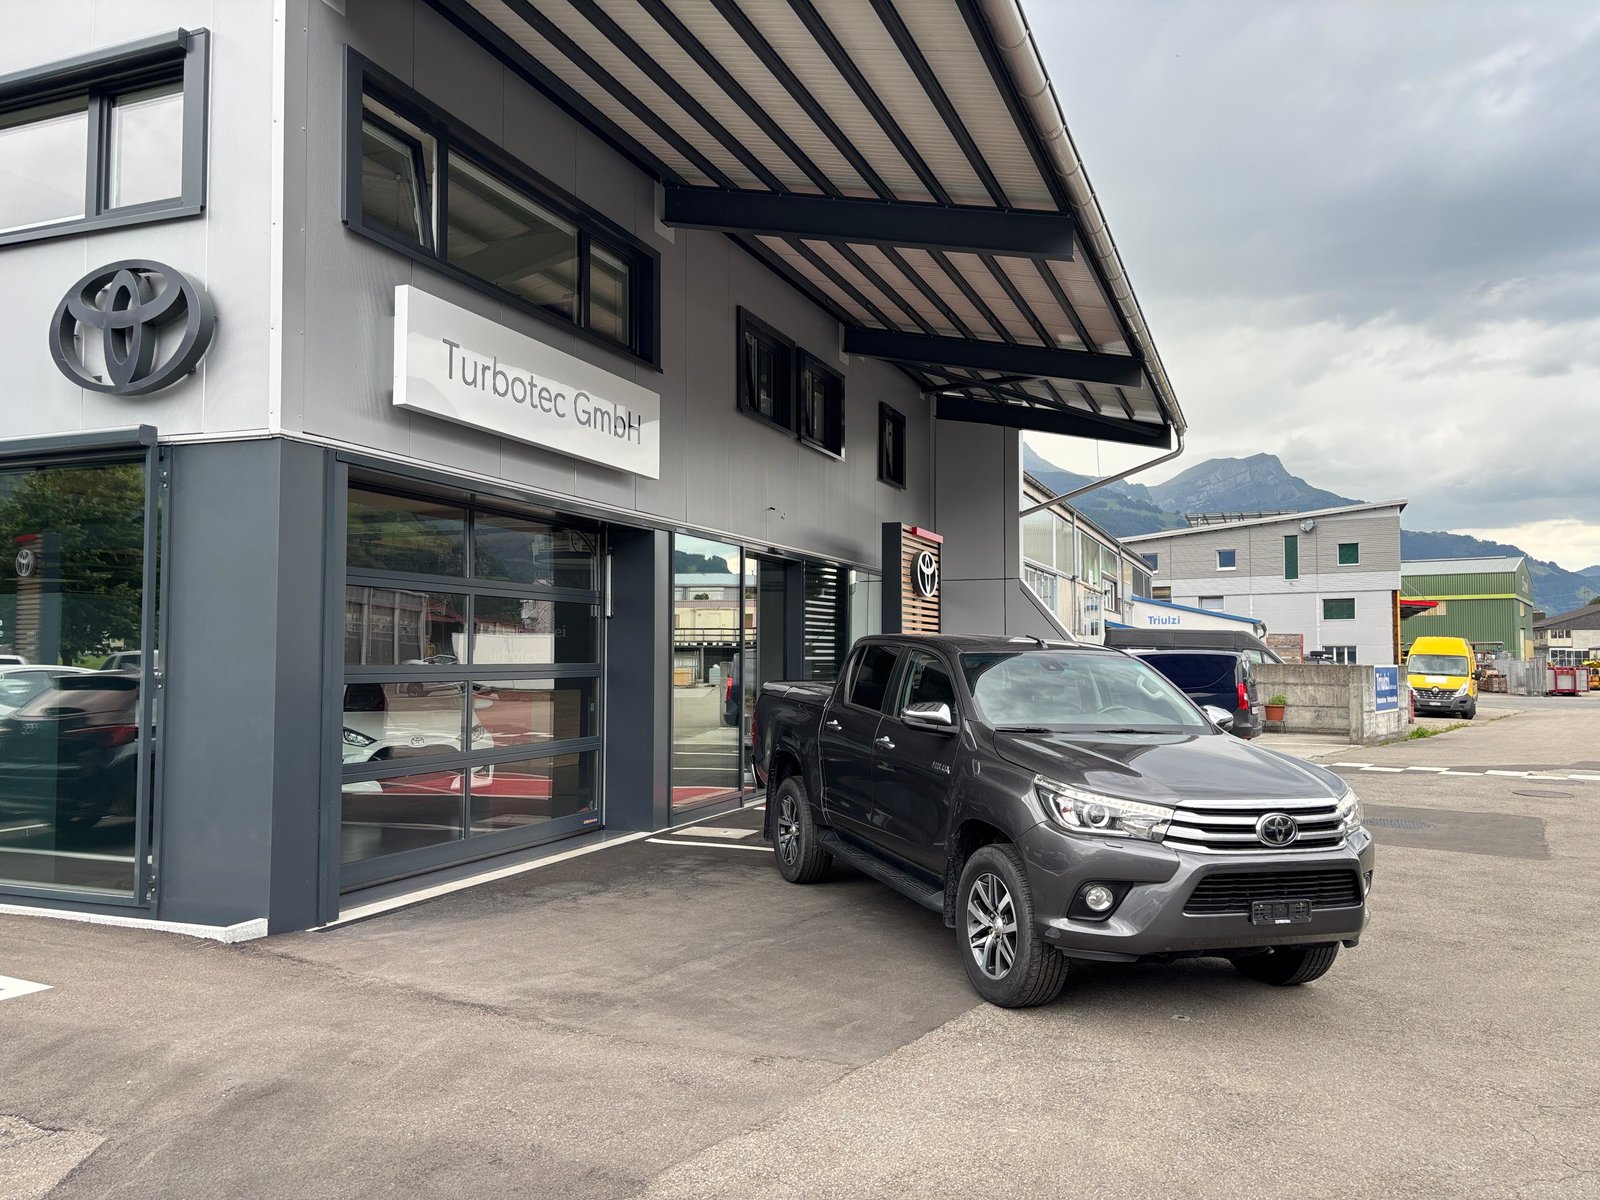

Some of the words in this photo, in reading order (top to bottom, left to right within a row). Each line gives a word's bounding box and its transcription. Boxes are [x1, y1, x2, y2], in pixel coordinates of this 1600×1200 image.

[442, 338, 566, 418] Turbotec
[573, 391, 641, 445] GmbH
[1148, 615, 1181, 625] Triulzi
